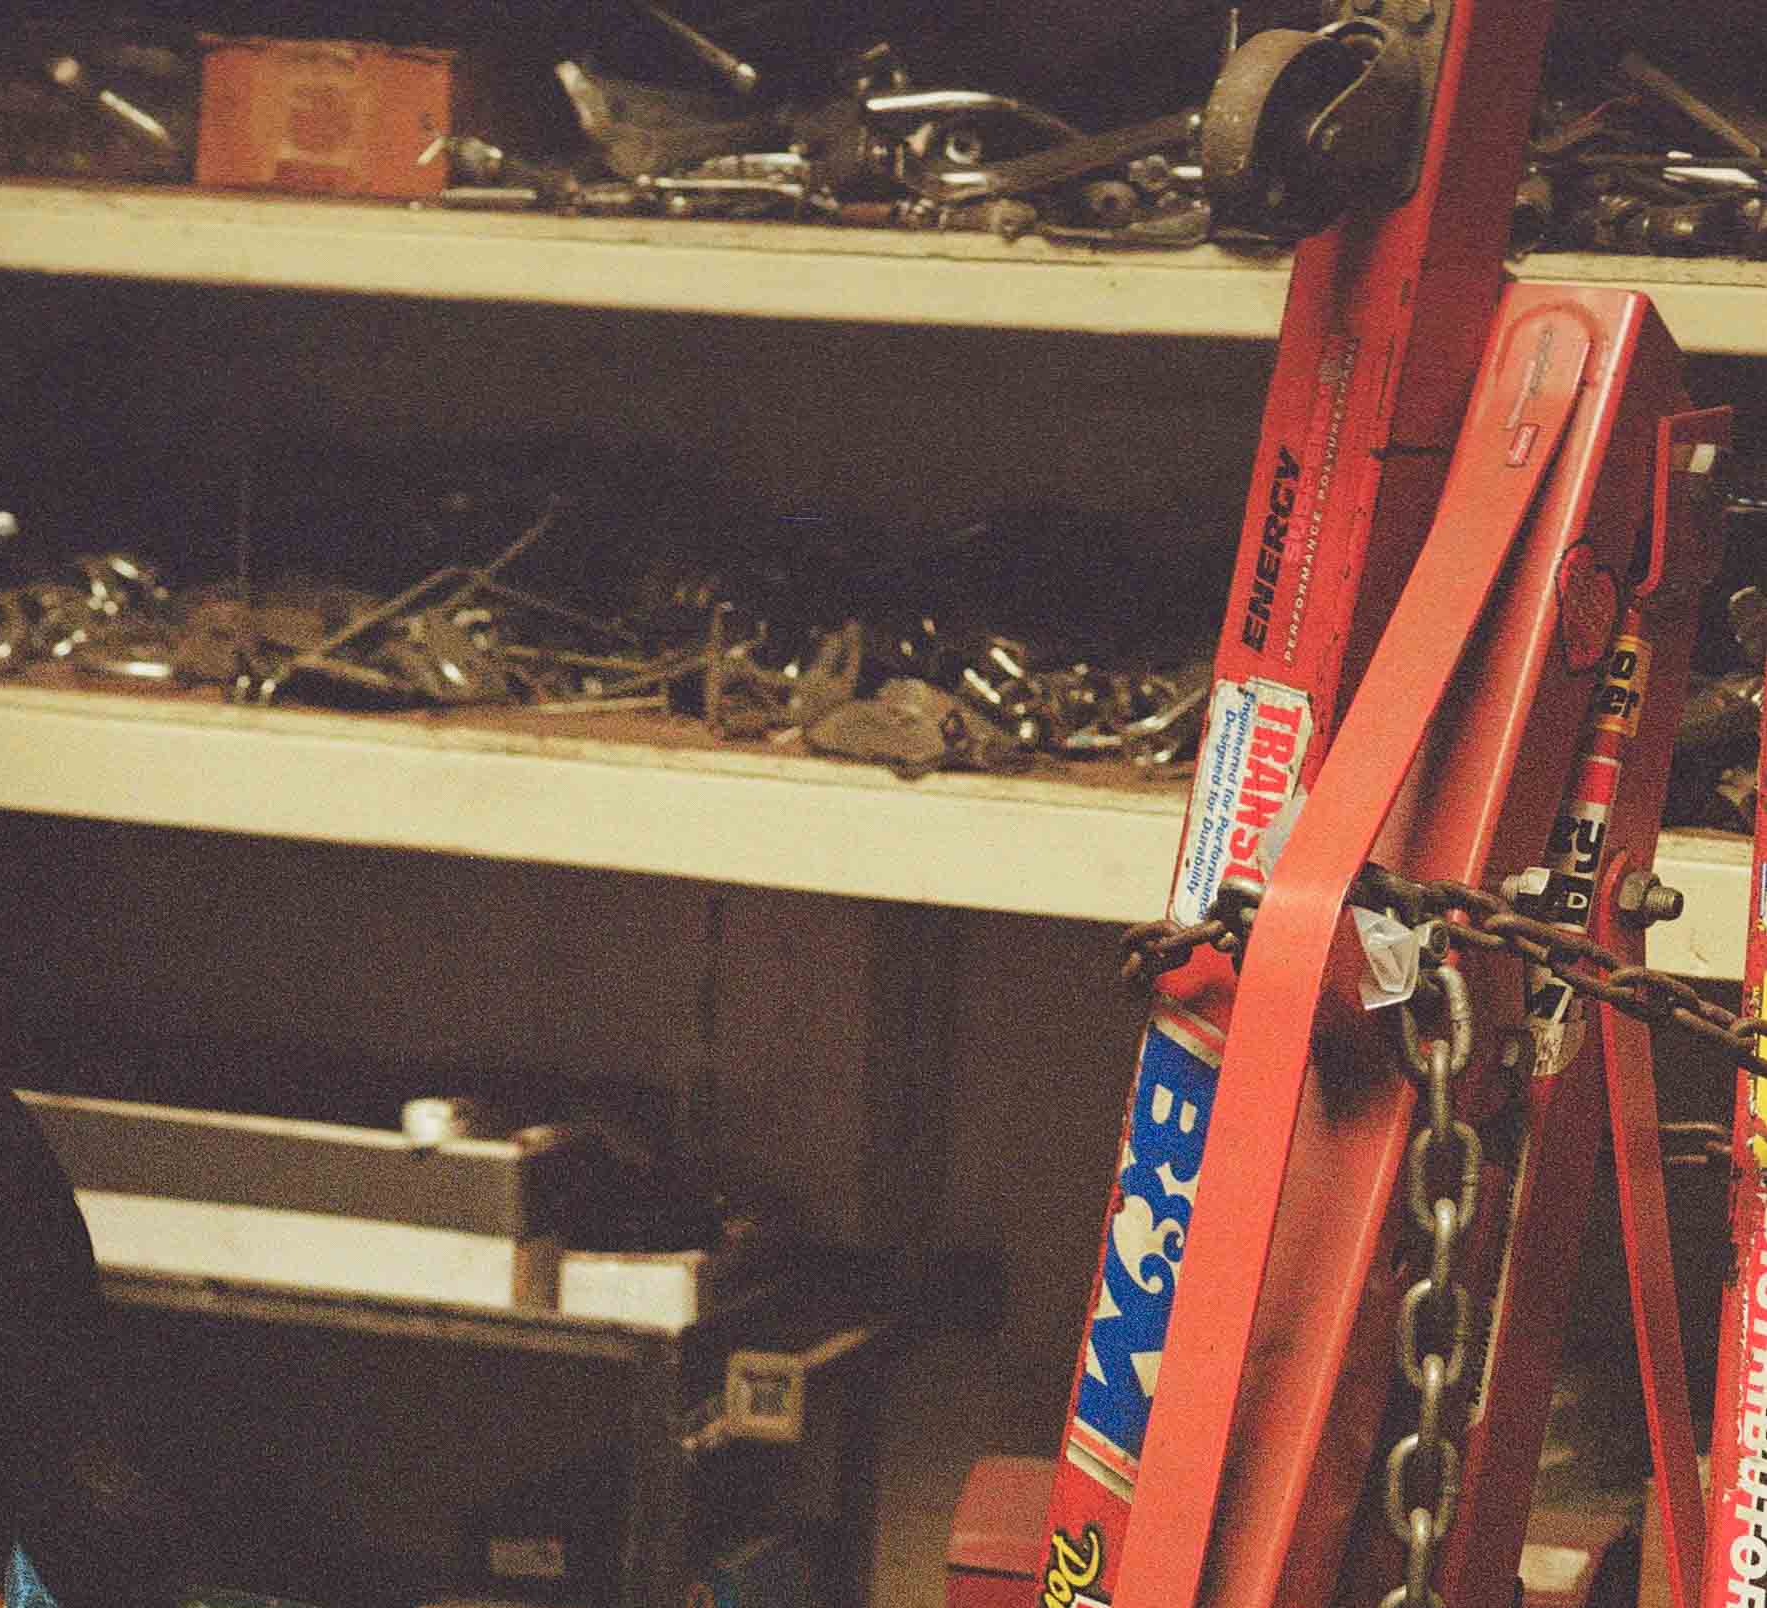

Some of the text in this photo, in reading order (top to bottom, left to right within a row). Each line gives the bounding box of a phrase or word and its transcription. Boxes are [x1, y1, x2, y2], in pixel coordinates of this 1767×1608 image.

[1241, 447, 1300, 652] ENERGY
[1283, 509, 1322, 662] PERFORMANCE
[1185, 708, 1238, 897] Designed for Durability
[1219, 785, 1235, 811] for
[1226, 690, 1258, 784] Engineered
